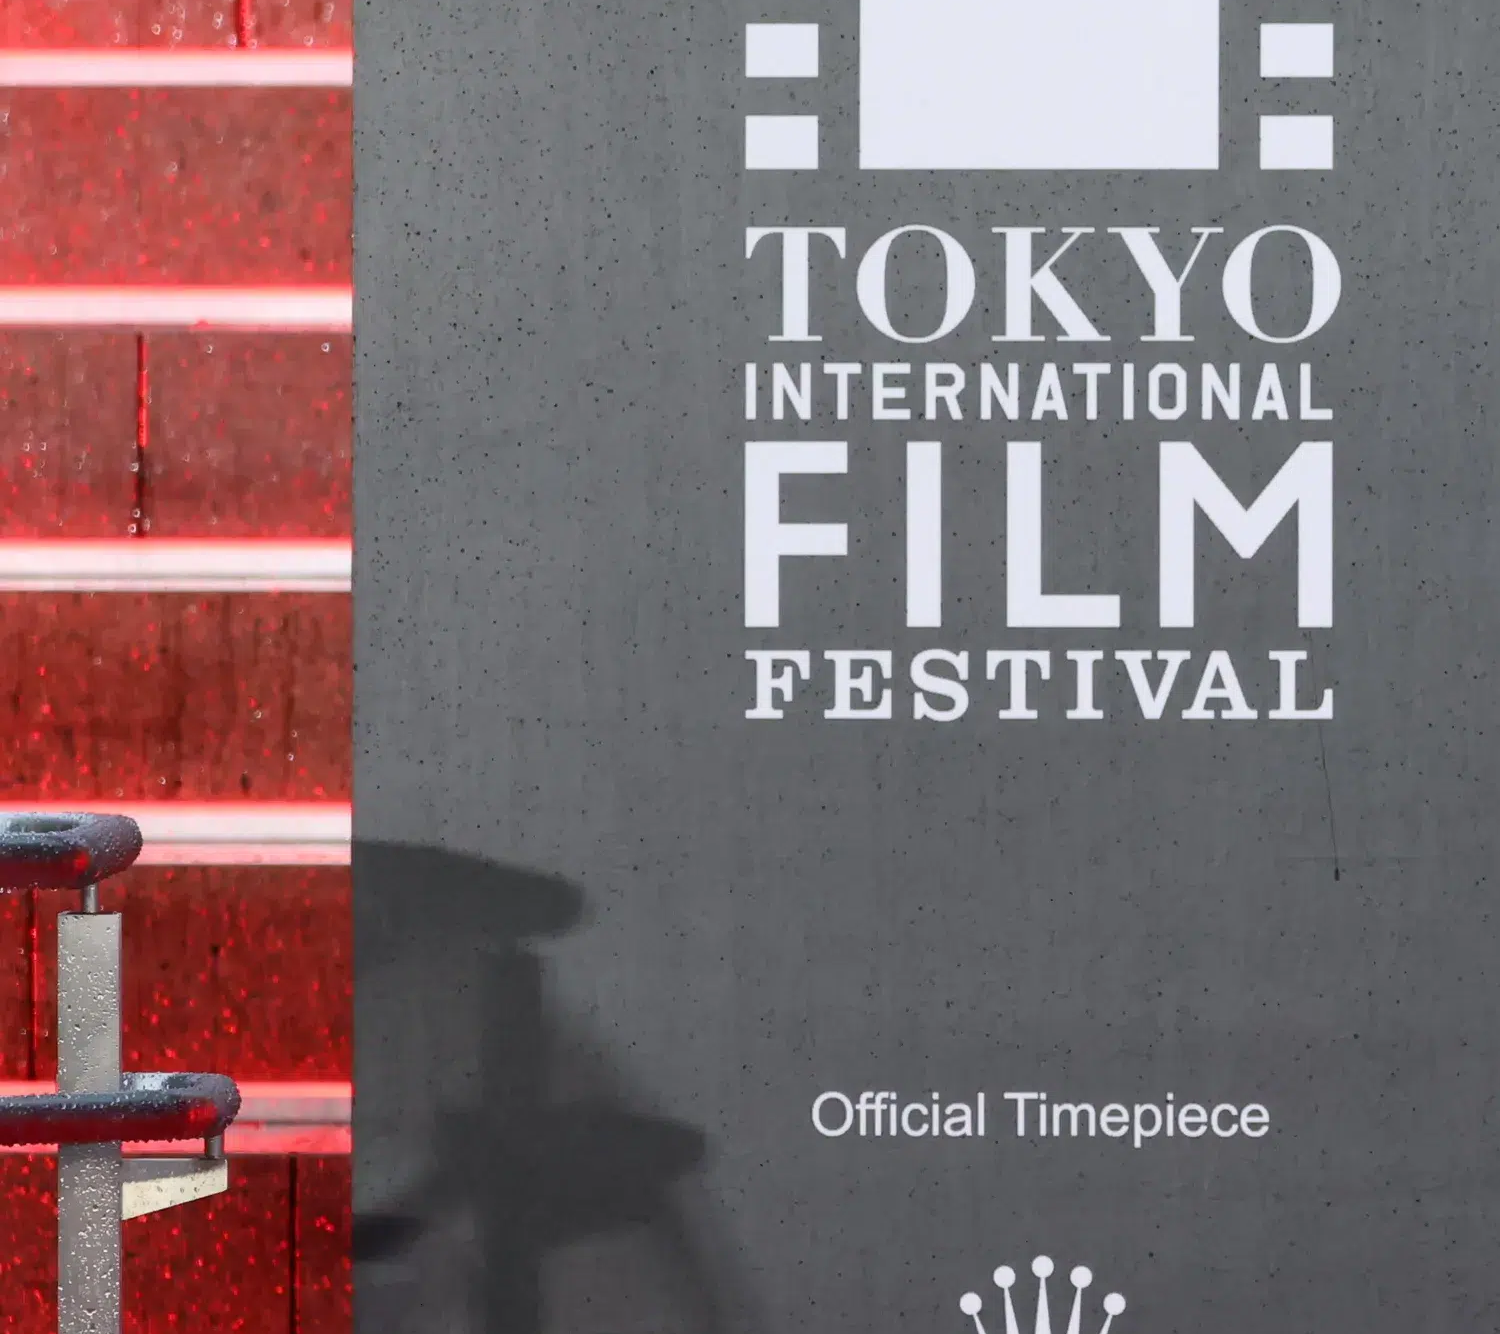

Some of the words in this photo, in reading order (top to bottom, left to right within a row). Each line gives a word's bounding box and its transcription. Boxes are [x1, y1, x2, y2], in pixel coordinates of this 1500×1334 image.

[744, 224, 1342, 344] TOKYO
[744, 362, 1334, 421] INTERNATIONAL
[743, 440, 1334, 628] FILM
[744, 649, 1334, 721] FESTIVAL
[811, 1090, 985, 1137] Official
[1003, 1091, 1270, 1149] Timepiece
